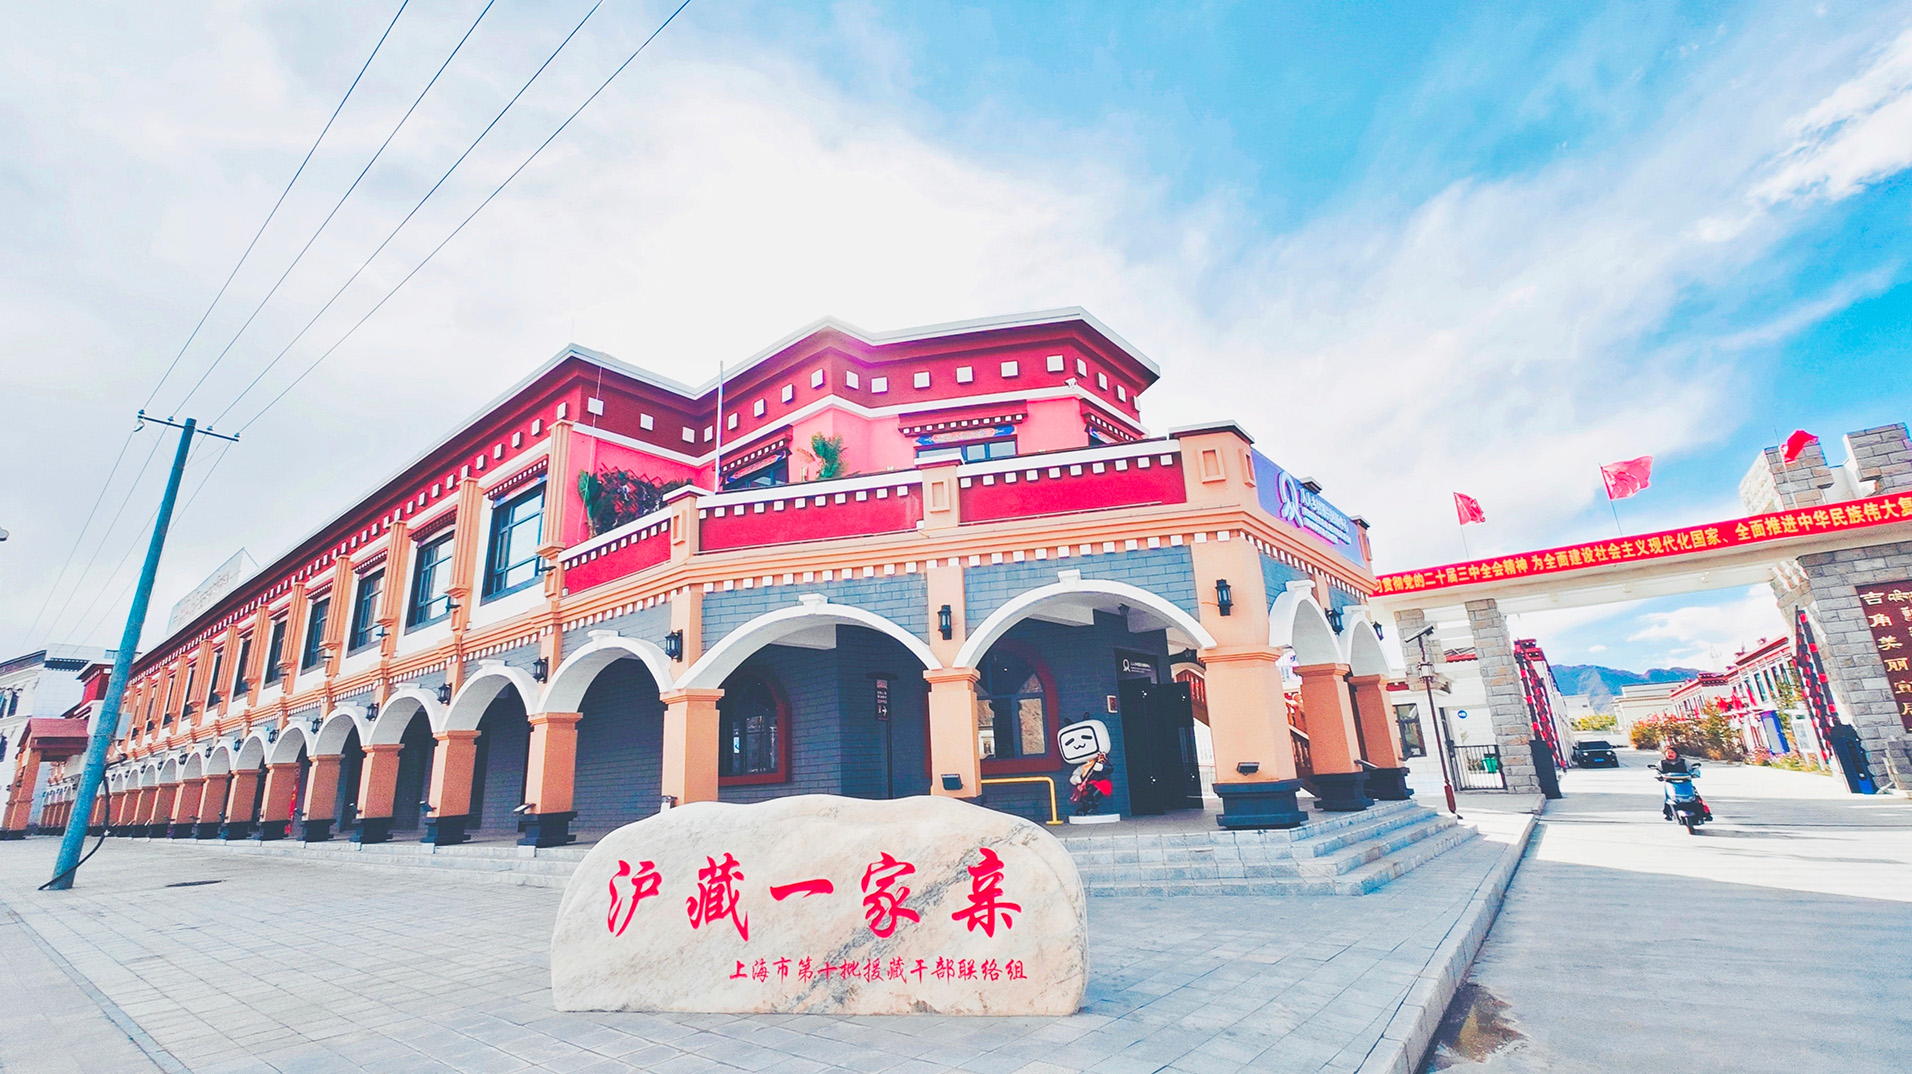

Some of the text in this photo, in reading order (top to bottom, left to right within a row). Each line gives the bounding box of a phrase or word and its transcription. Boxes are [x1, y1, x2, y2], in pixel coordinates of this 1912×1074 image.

[1860, 590, 1912, 732] 吉角美丽宜
[607, 846, 1022, 942] 沪藏一家亲
[729, 955, 1028, 983] 上海市第十批援藏干部联络组
